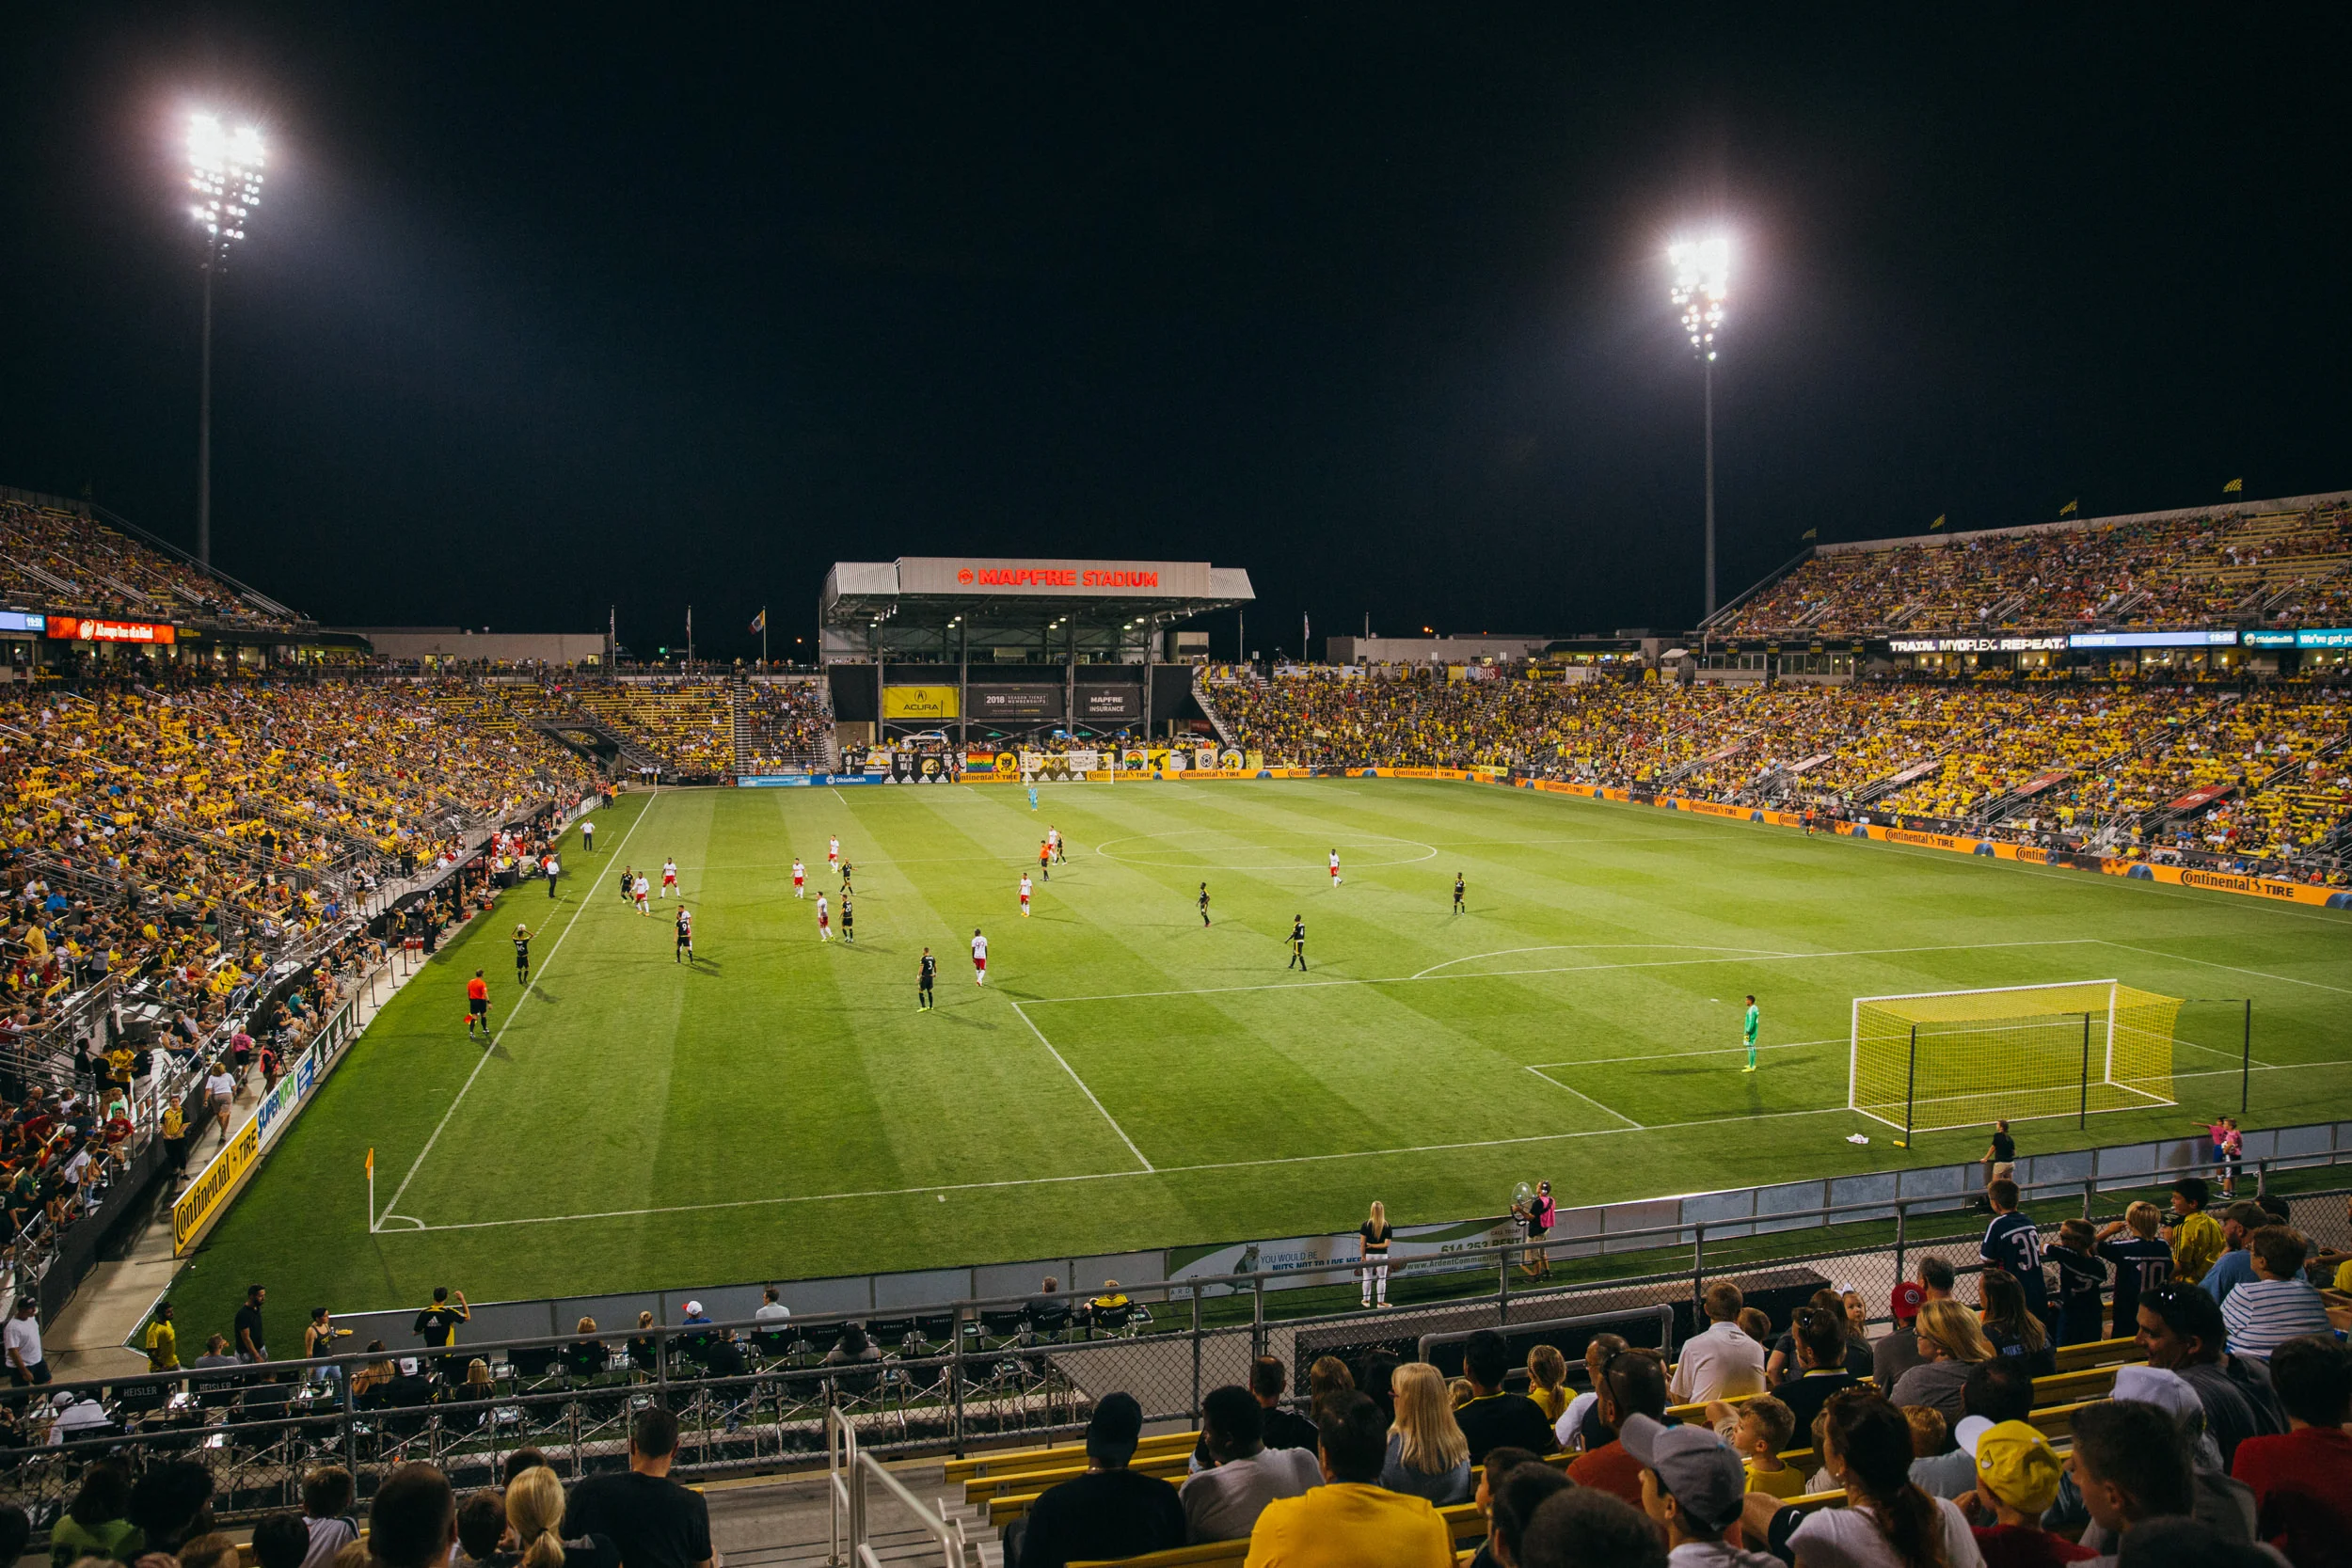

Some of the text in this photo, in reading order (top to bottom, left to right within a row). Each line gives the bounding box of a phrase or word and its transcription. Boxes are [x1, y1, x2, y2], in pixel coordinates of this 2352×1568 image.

[977, 567, 1158, 588] MAPFRE STADIUM
[1889, 641, 1936, 652] TRAIN.
[1938, 639, 1998, 651] MYOPLEX.
[2000, 638, 2065, 650] REPEAT.
[2299, 633, 2327, 643] We've
[2328, 634, 2343, 646] got
[986, 695, 1006, 704] 2018
[903, 703, 939, 711] ACURA
[1178, 770, 1218, 780] Continental
[1393, 768, 1433, 778] Continental
[1572, 786, 1583, 795] TIRE
[1689, 800, 1738, 816] Continental TIRE
[1884, 828, 1955, 848] Continental TIRE
[2180, 869, 2294, 897] Continental TIRE
[682, 923, 688, 931] 9
[975, 941, 985, 949] 99
[928, 960, 933, 971] 3
[257, 1070, 296, 1140] SUPERKICK
[175, 1125, 257, 1245] Continental TIRE
[1441, 1243, 1463, 1252] 614
[1260, 1249, 1318, 1264] YOU WOULD BE
[2136, 1260, 2166, 1294] 10
[123, 1386, 158, 1397] HEISLER
[199, 1382, 232, 1393] HEISLER
